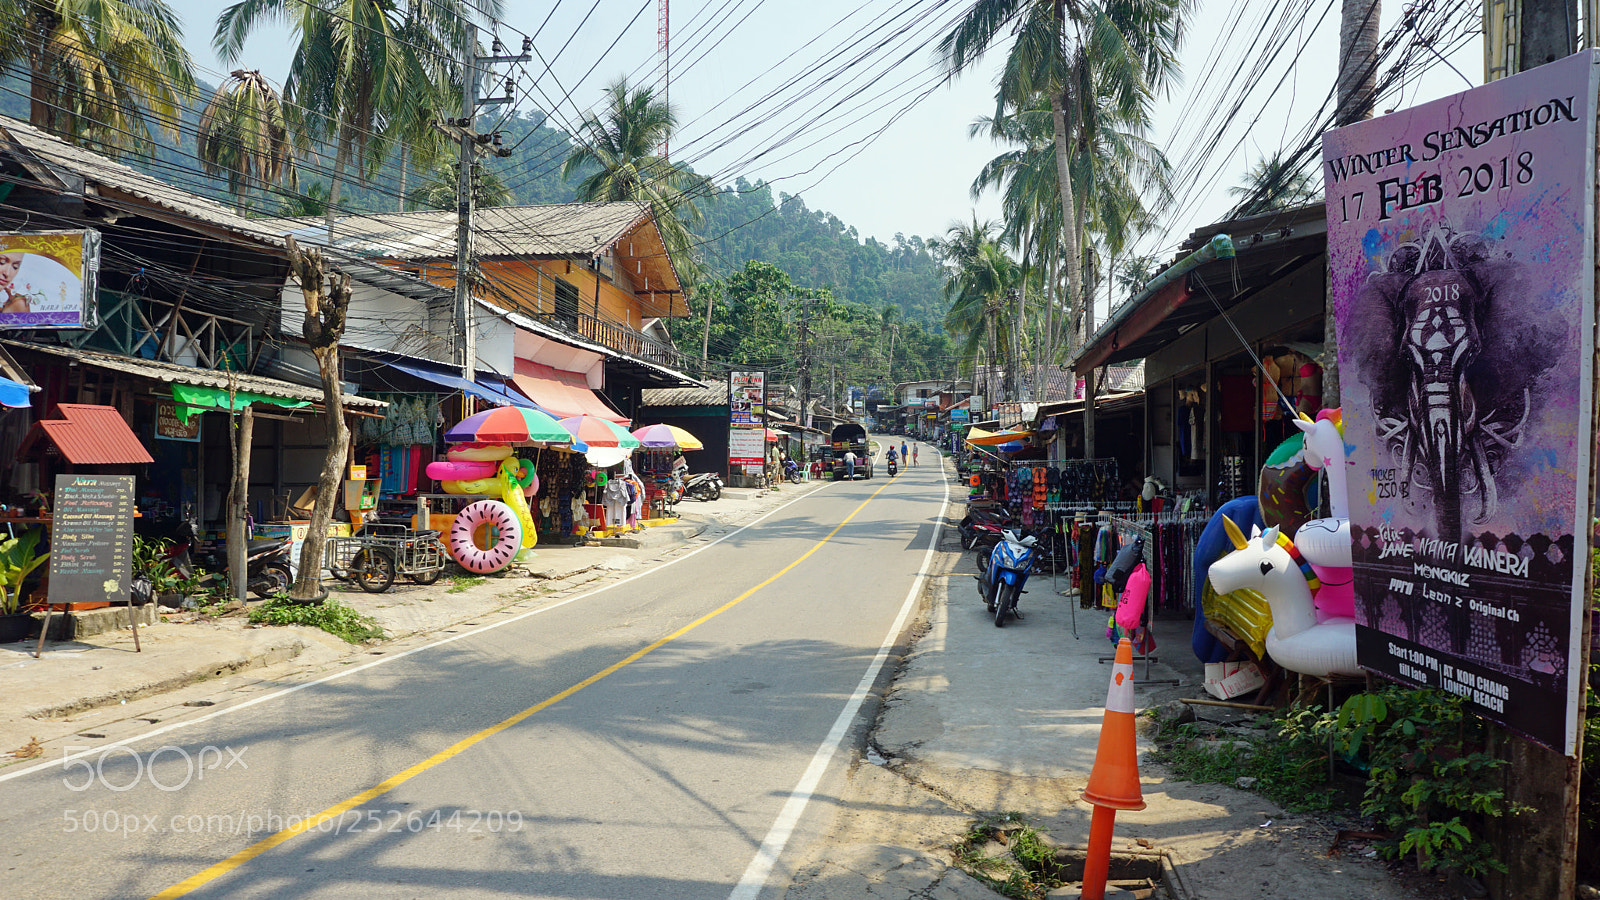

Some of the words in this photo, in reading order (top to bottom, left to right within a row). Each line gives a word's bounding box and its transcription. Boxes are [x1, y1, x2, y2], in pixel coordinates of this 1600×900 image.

[1340, 192, 1364, 222] 17
[1457, 151, 1536, 199] 2018
[1424, 284, 1460, 303] 2018
[1371, 468, 1396, 481] TICKET
[79, 487, 104, 495] Massage
[1378, 482, 1397, 498] 250
[1400, 481, 1410, 499] B
[92, 513, 116, 521] Massage
[1420, 537, 1459, 564] NANA
[1469, 599, 1506, 619] Original
[1506, 608, 1520, 622] Ch
[1388, 642, 1408, 660] Start
[1408, 650, 1425, 667] 1:00
[1425, 655, 1439, 672] PM
[1399, 662, 1410, 678] till
[1411, 667, 1428, 683] late
[1443, 664, 1454, 679] AT
[1456, 669, 1476, 688] KOH
[1476, 676, 1509, 700] CHANG
[1473, 689, 1504, 714] BEACH
